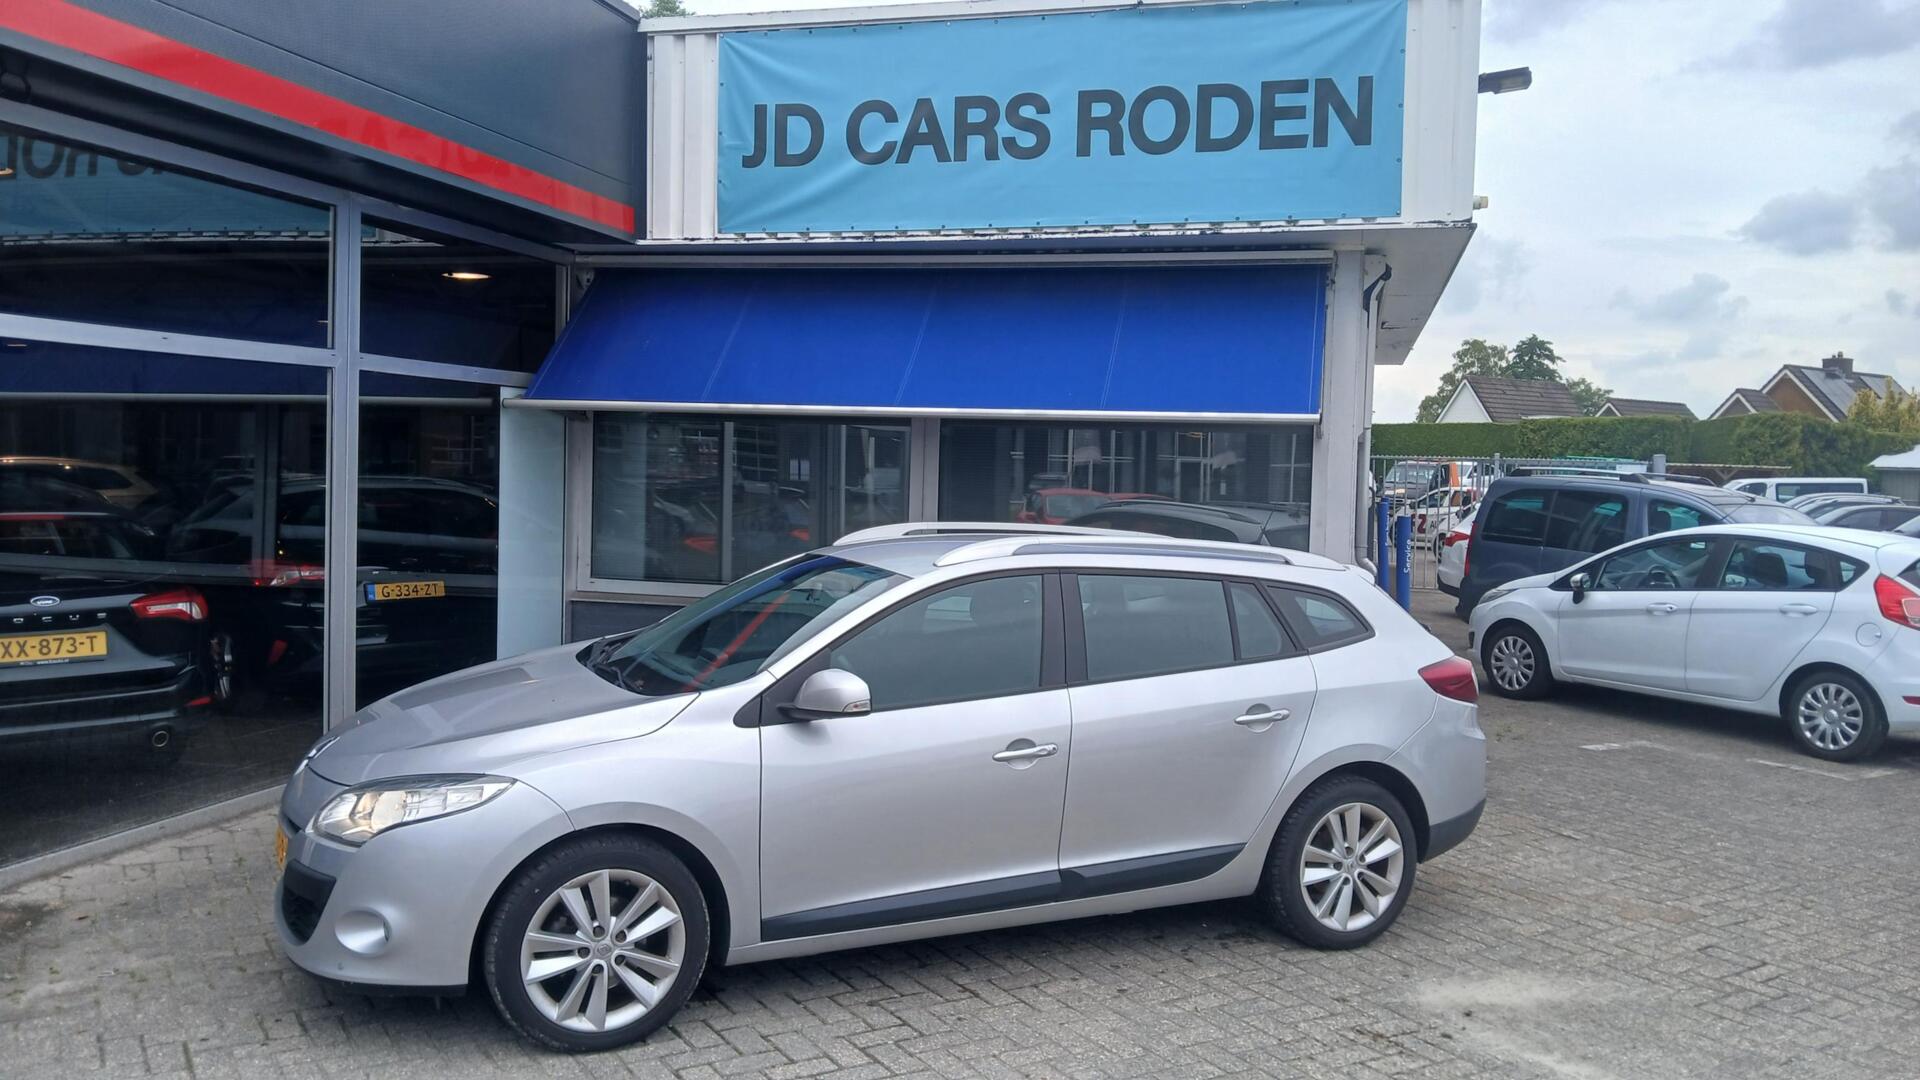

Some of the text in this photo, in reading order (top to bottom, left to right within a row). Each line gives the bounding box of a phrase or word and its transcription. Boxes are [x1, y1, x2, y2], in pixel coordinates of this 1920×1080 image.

[741, 75, 1374, 168] JD CARS RODEN
[1403, 539, 1411, 573] Service
[382, 583, 438, 598] G-334-ZT
[0, 635, 98, 659] XX-873-T
